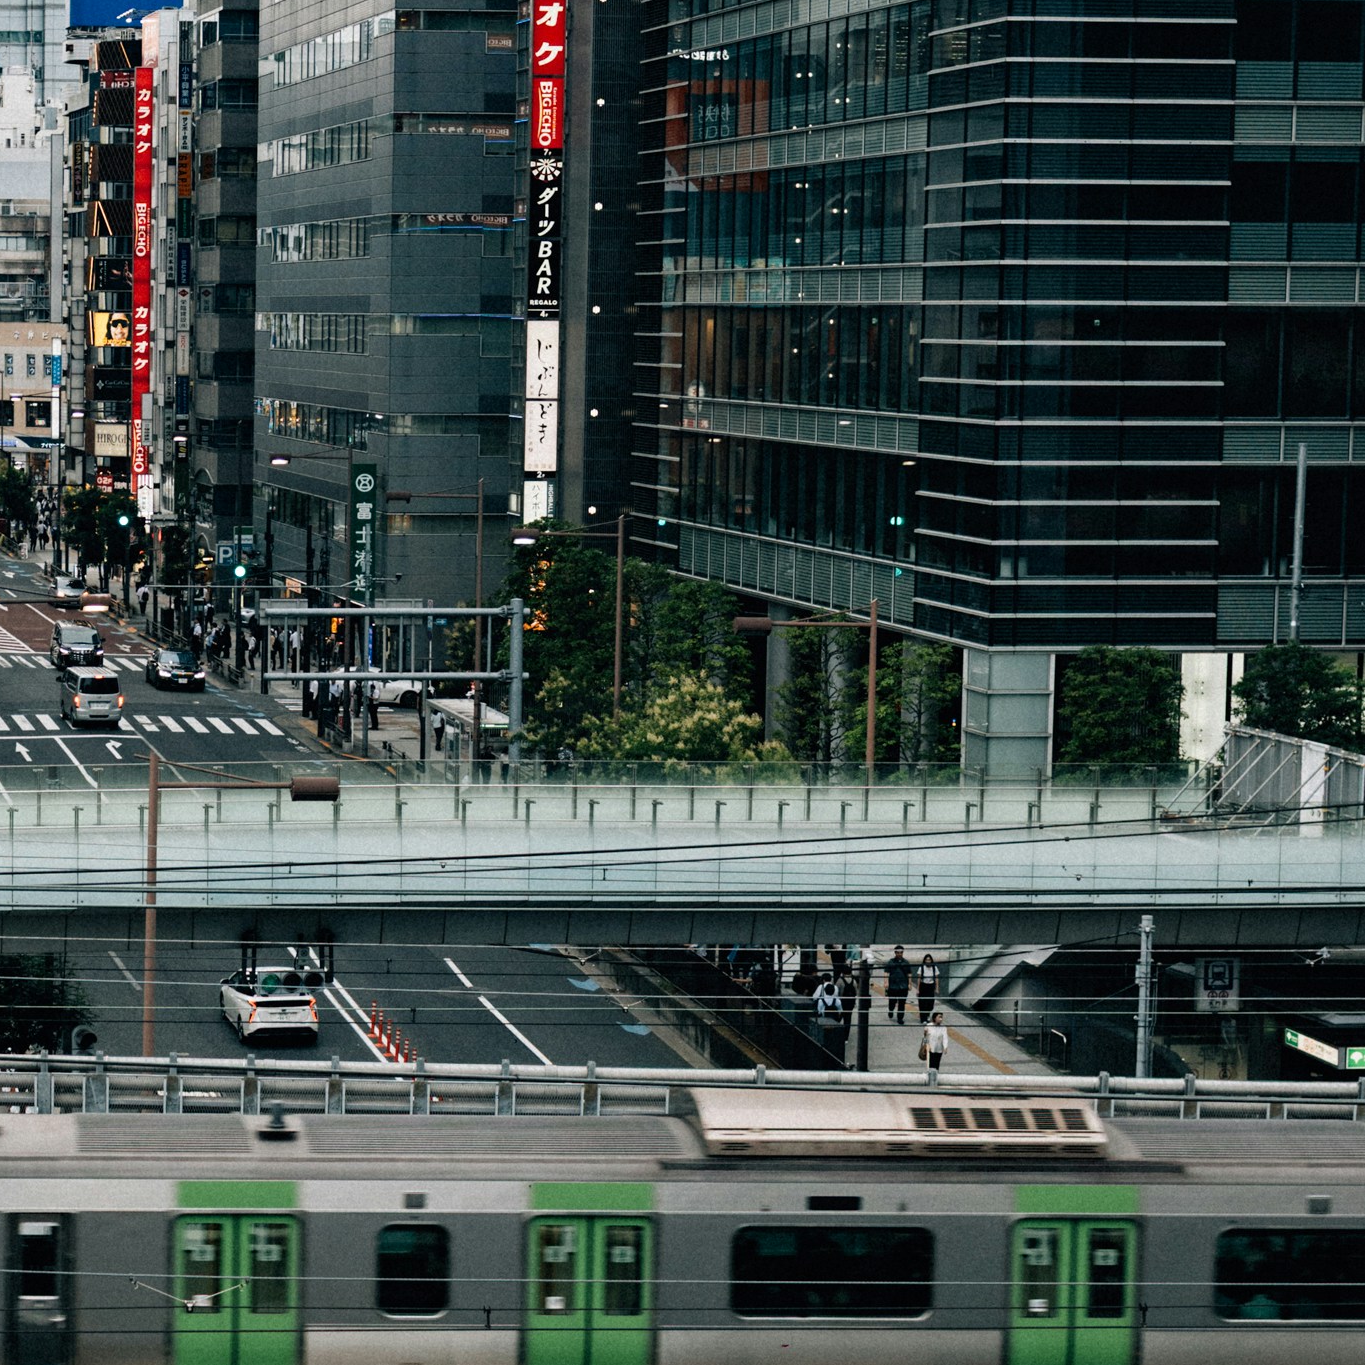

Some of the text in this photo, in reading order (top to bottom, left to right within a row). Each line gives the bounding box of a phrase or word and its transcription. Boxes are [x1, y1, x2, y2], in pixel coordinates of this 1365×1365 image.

[136, 88, 151, 154] カラオケ
[535, 186, 558, 295] ダーツ BAR
[134, 306, 149, 370] カラオケ
[536, 338, 555, 444] じぶんどき
[97, 432, 128, 446] HIROGI
[531, 483, 542, 519] ハイボー
[219, 547, 233, 564] P
